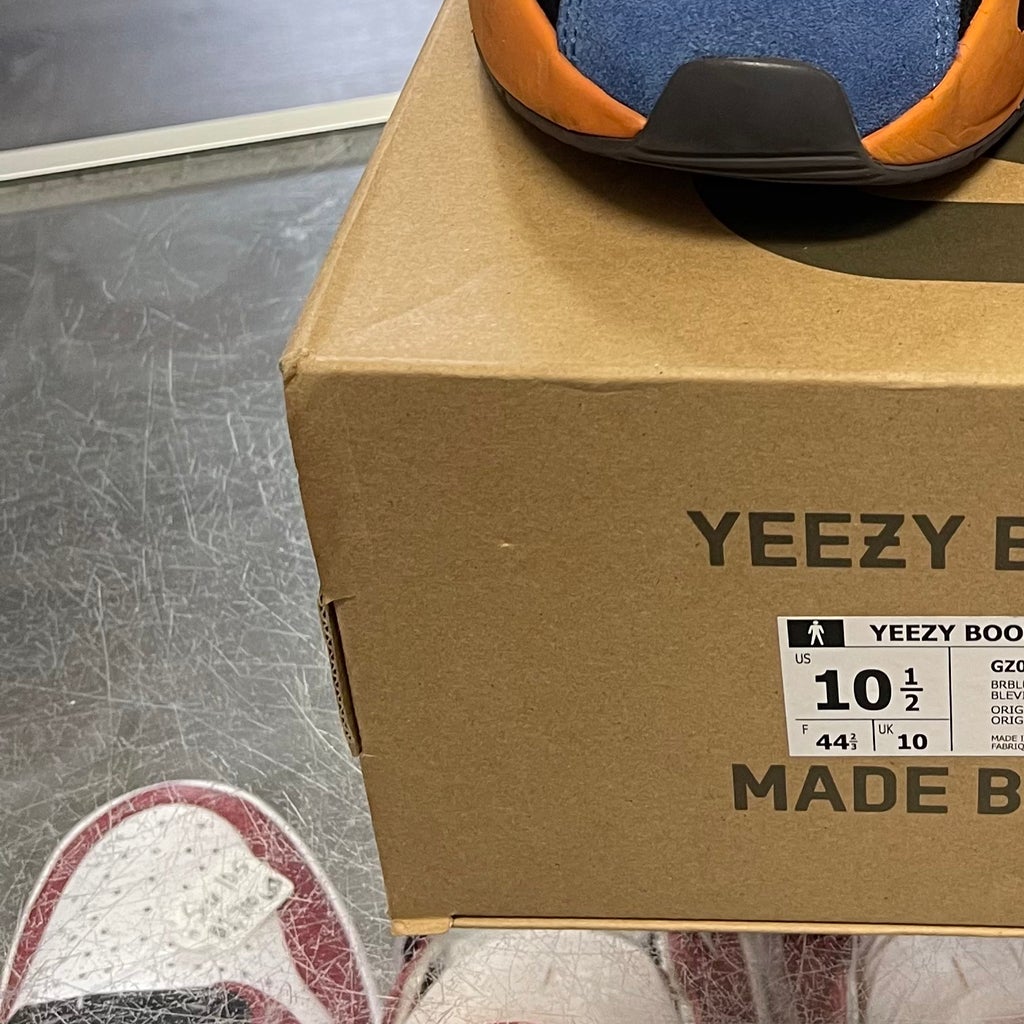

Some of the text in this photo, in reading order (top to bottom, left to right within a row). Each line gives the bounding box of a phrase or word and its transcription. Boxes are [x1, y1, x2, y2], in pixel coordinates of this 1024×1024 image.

[869, 624, 956, 642] YEEZY
[795, 653, 811, 664] US
[815, 669, 892, 711] 10
[802, 725, 809, 734] F
[878, 724, 894, 734] UK
[816, 734, 850, 750] 44
[898, 734, 928, 750] 10
[732, 763, 949, 814] MADE
